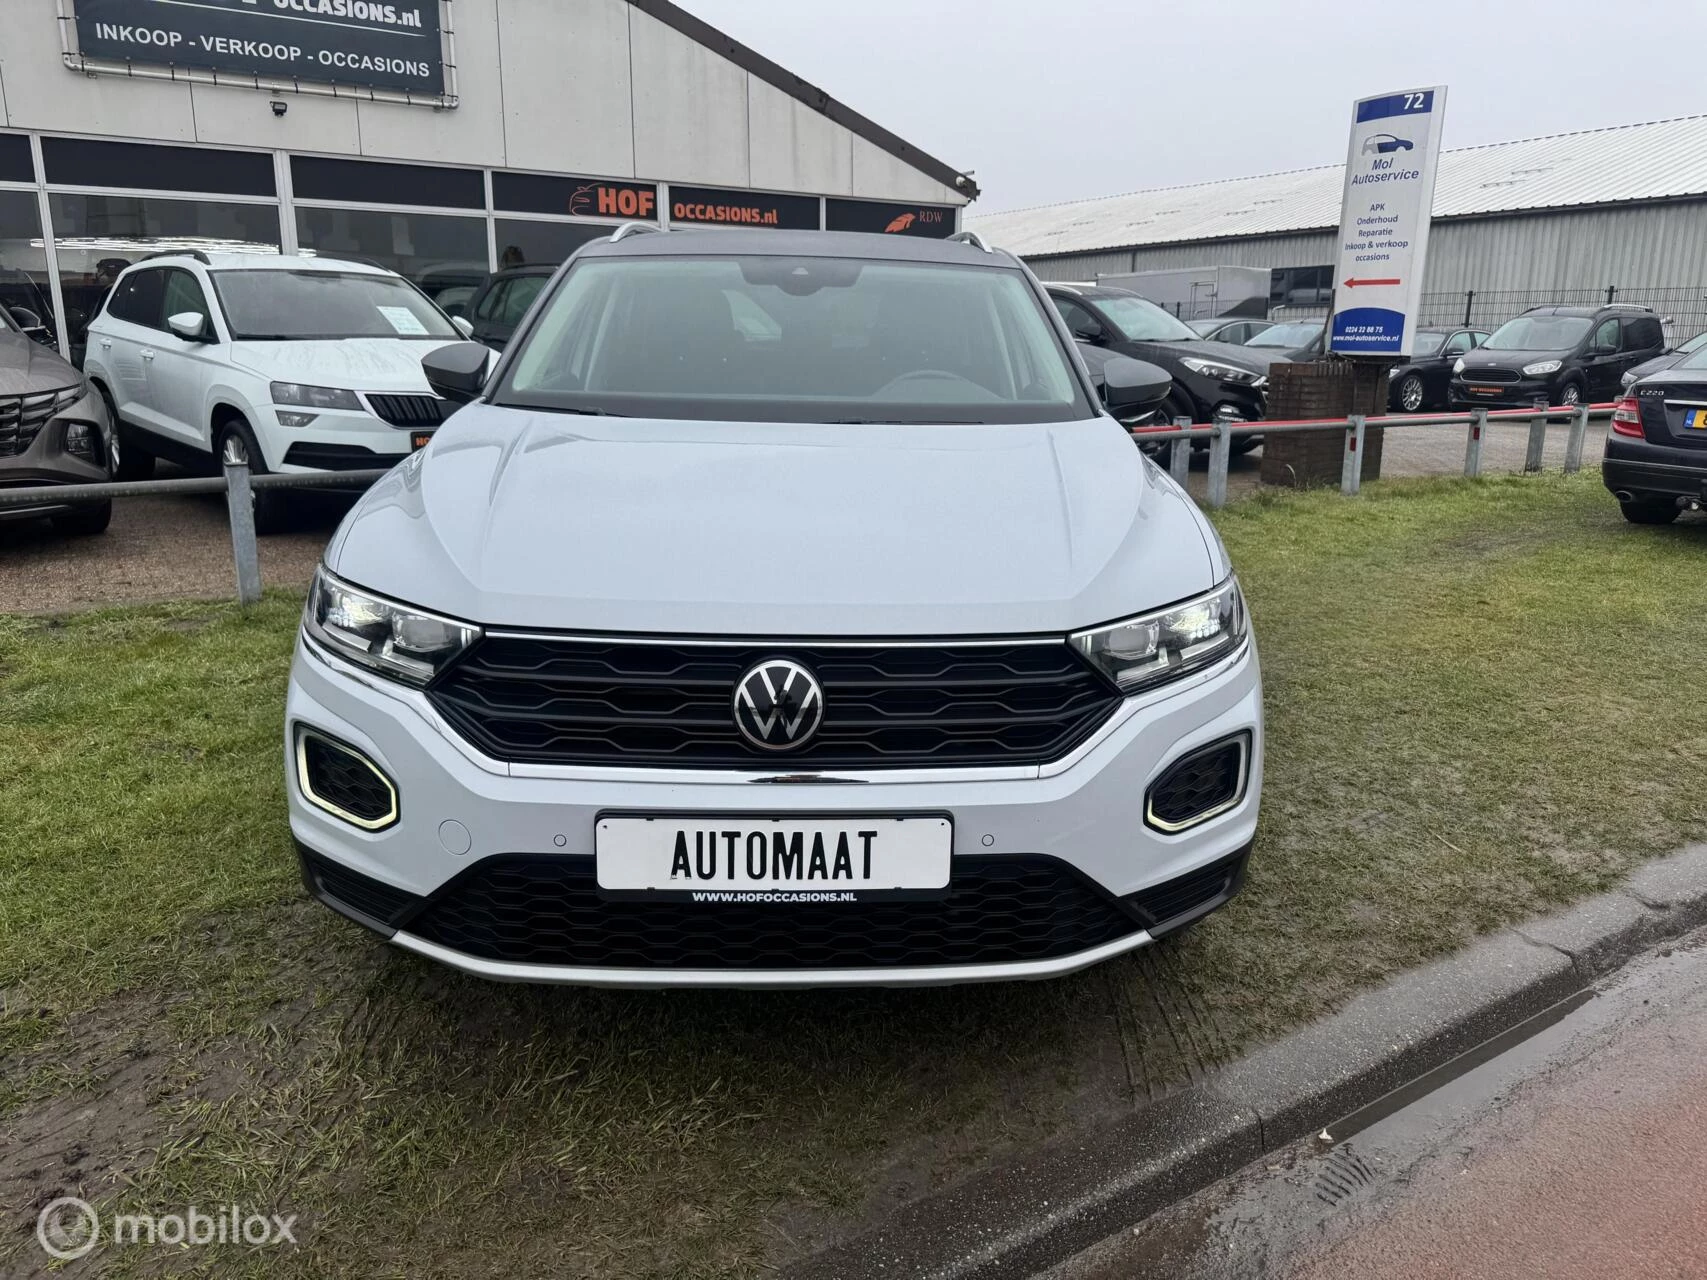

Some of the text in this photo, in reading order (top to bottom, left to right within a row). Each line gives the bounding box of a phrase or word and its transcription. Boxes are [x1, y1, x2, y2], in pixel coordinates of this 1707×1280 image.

[95, 23, 182, 48] INKOOP
[201, 35, 301, 61] VERKOOP
[318, 50, 430, 78] OCCASIONS
[1403, 93, 1424, 110] 72
[1371, 157, 1393, 171] Mol
[1351, 169, 1419, 186] Autoservice
[597, 187, 778, 225] HOF OCCASIONS.nl
[1369, 203, 1385, 212] APK
[919, 210, 943, 223] RDW
[1356, 215, 1398, 226] Onderhoud
[1358, 228, 1393, 238] Reparatie
[1345, 239, 1408, 251] Inkoop & verkoop
[1355, 253, 1389, 262] occasions
[670, 830, 878, 880] AUTOMAAT
[692, 891, 857, 902] WWW.HOFOCCASIONS.NL
